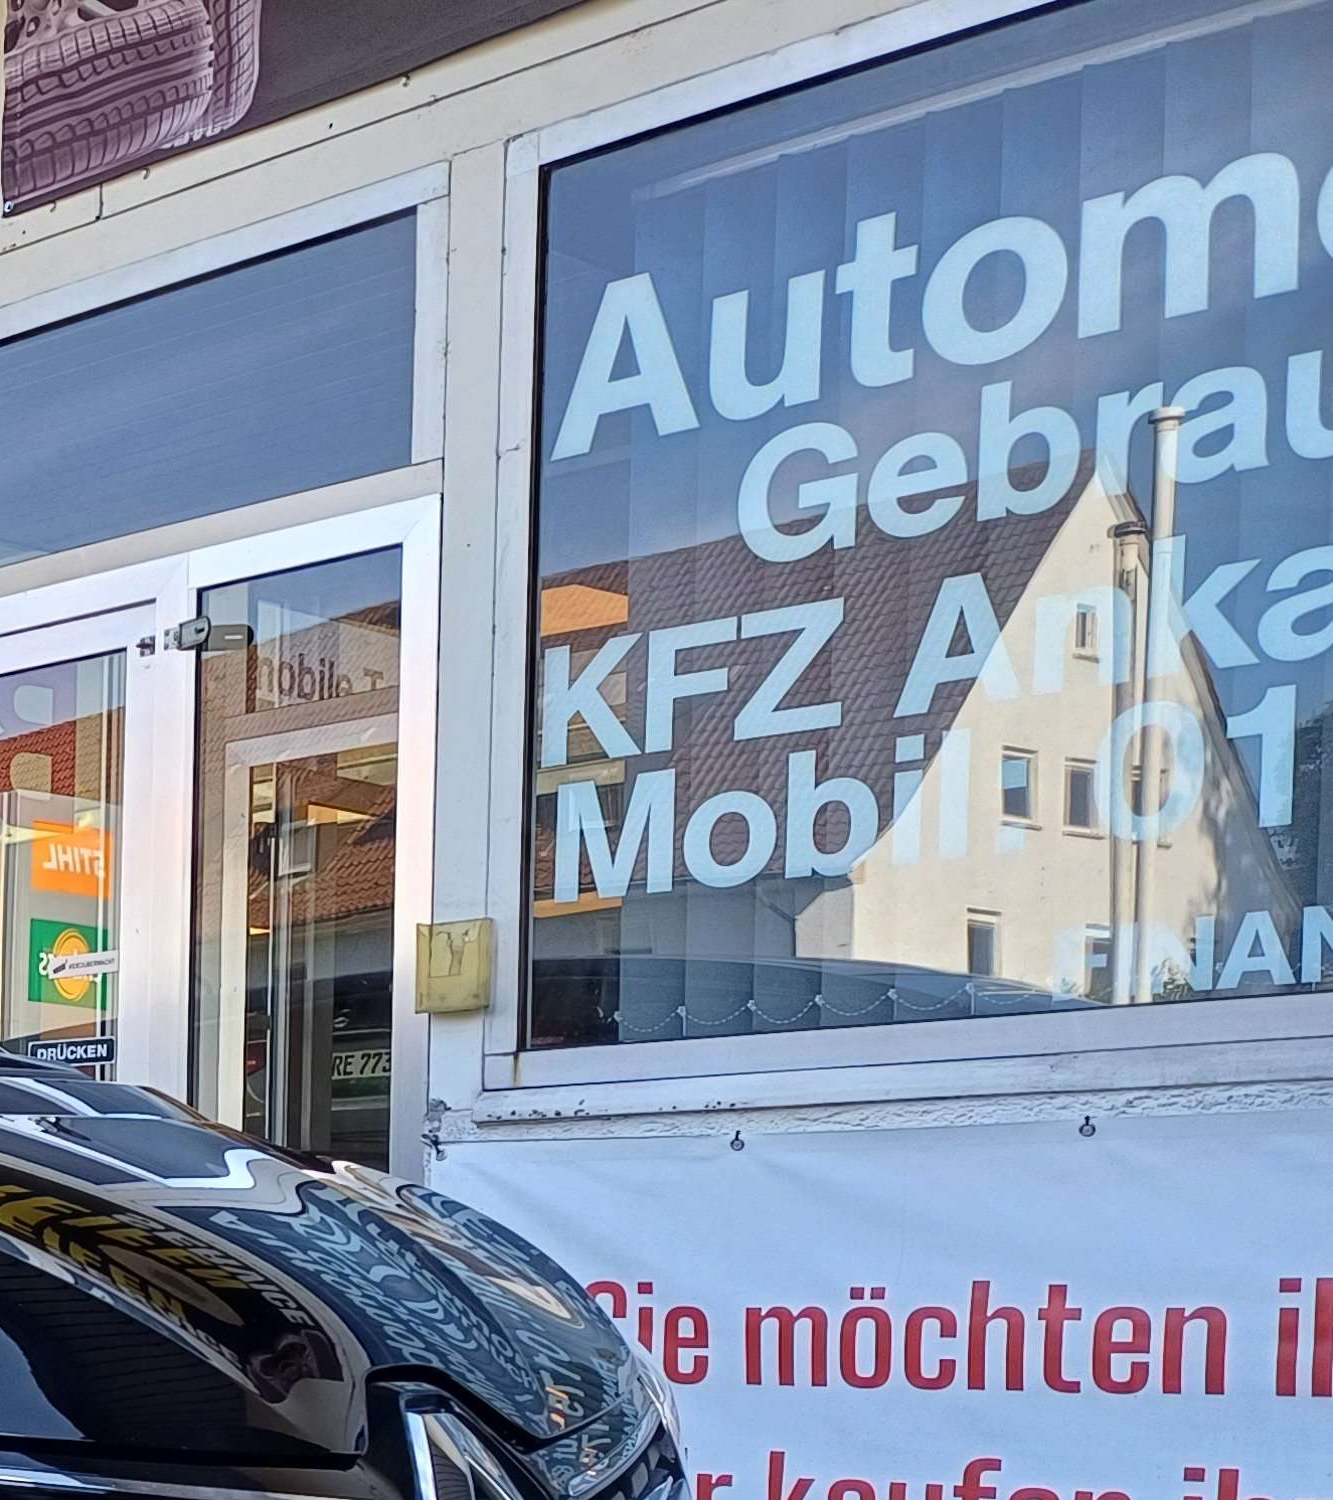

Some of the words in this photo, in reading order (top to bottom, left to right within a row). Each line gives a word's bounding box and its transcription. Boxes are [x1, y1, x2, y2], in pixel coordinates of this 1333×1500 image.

[550, 151, 1333, 463] Autom
[540, 597, 845, 768] KFZ
[36, 1043, 108, 1062] DRÜCKEN
[744, 1280, 1229, 1396] möchten
[1275, 1277, 1333, 1399] i
